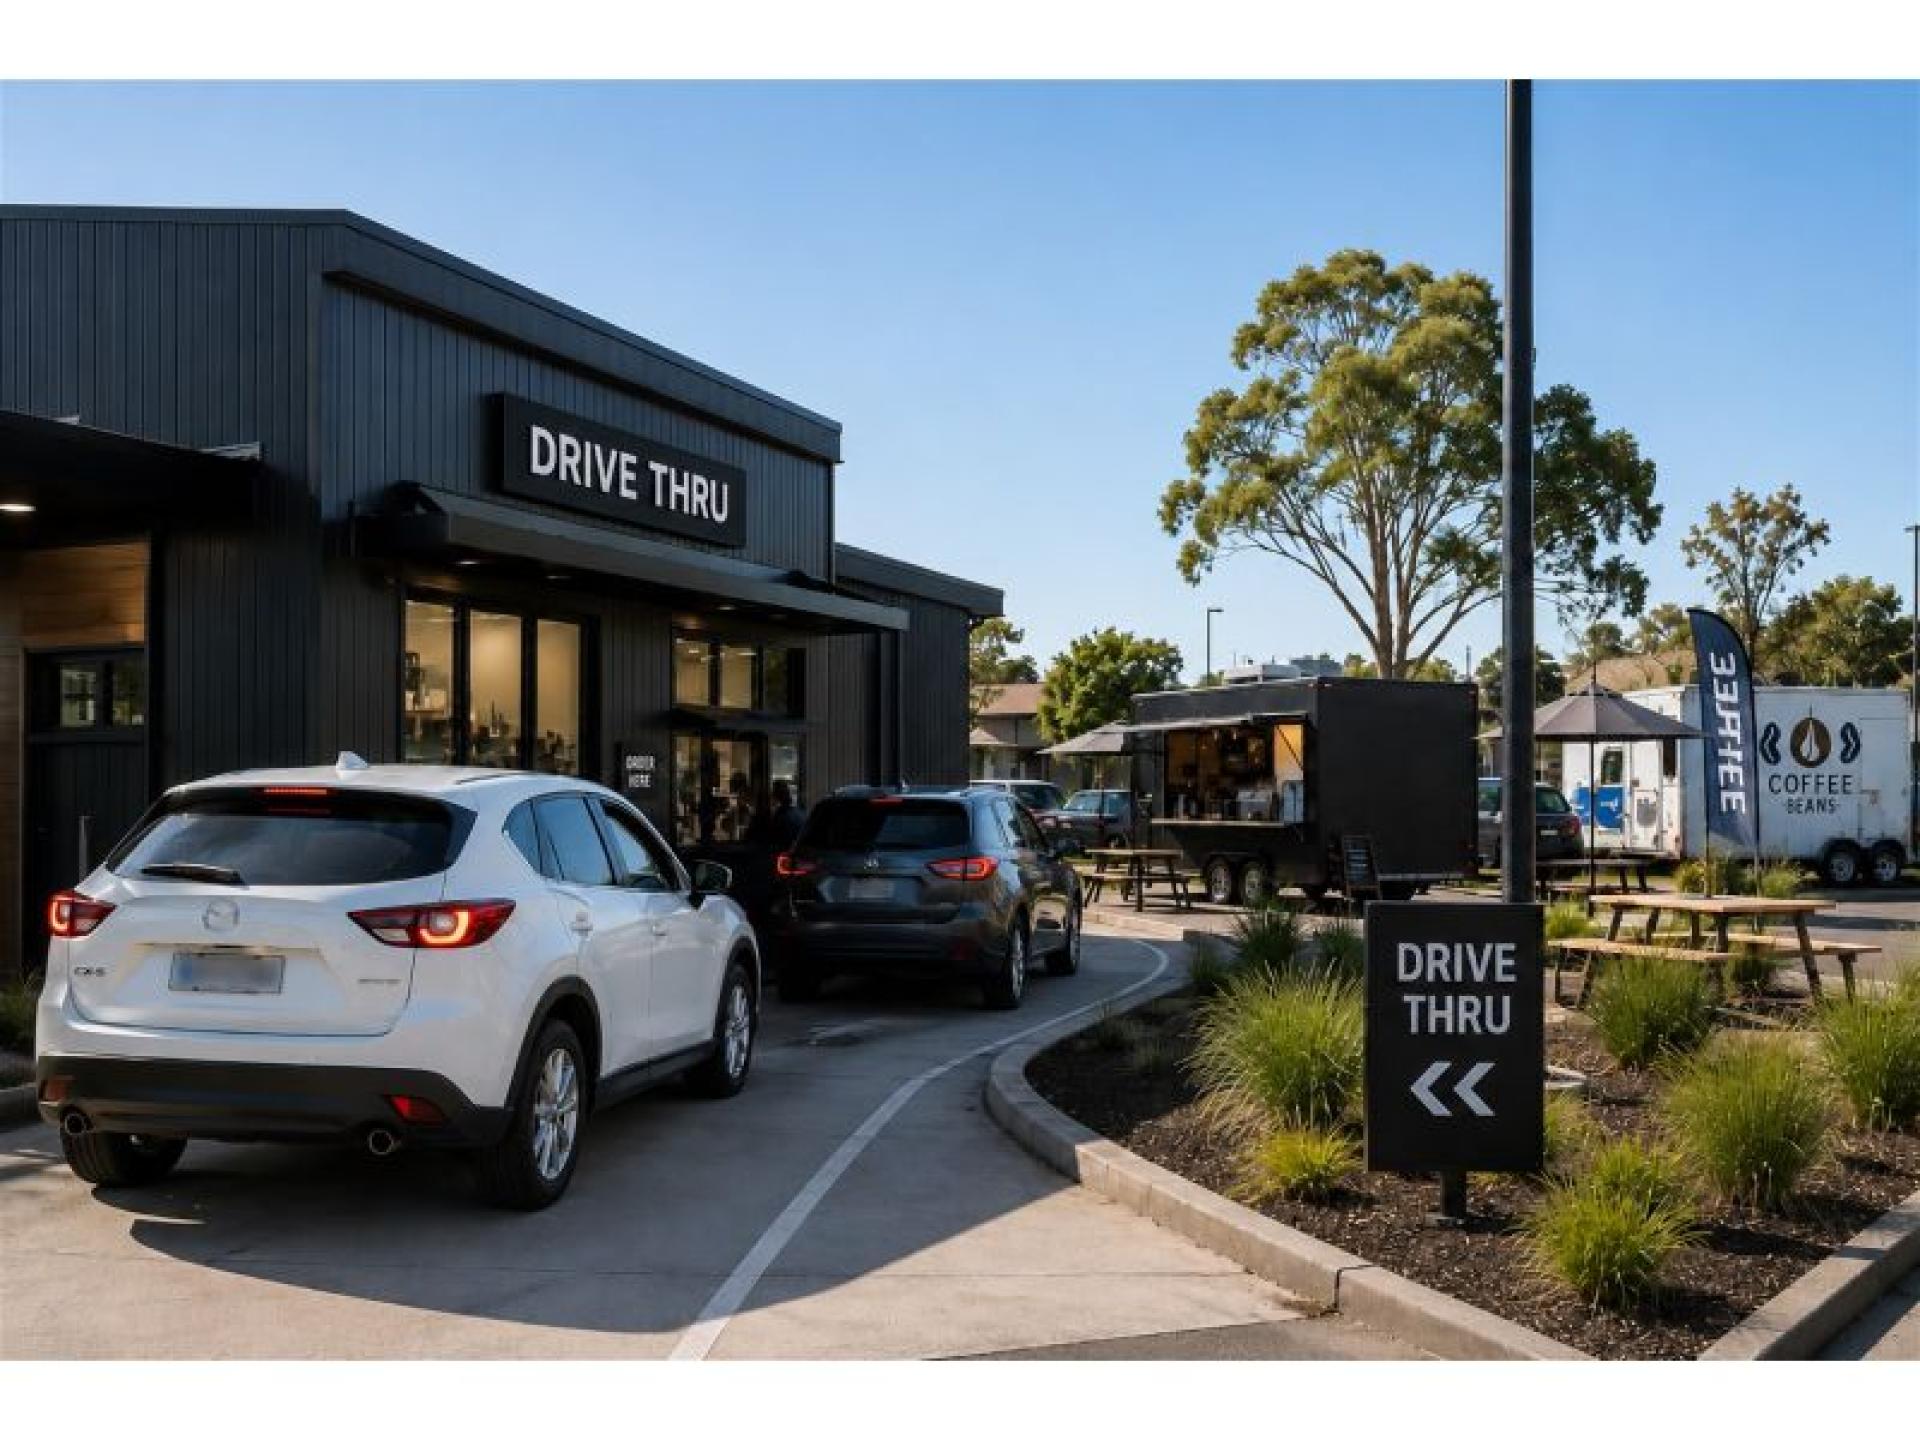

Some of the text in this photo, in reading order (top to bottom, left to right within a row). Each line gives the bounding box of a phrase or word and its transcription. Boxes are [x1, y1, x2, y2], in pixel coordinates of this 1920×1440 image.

[531, 424, 729, 524] DRIVE THRU
[1768, 774, 1853, 795] COFFEE
[1398, 942, 1517, 983] DRIVE
[1403, 994, 1511, 1035] THRU
